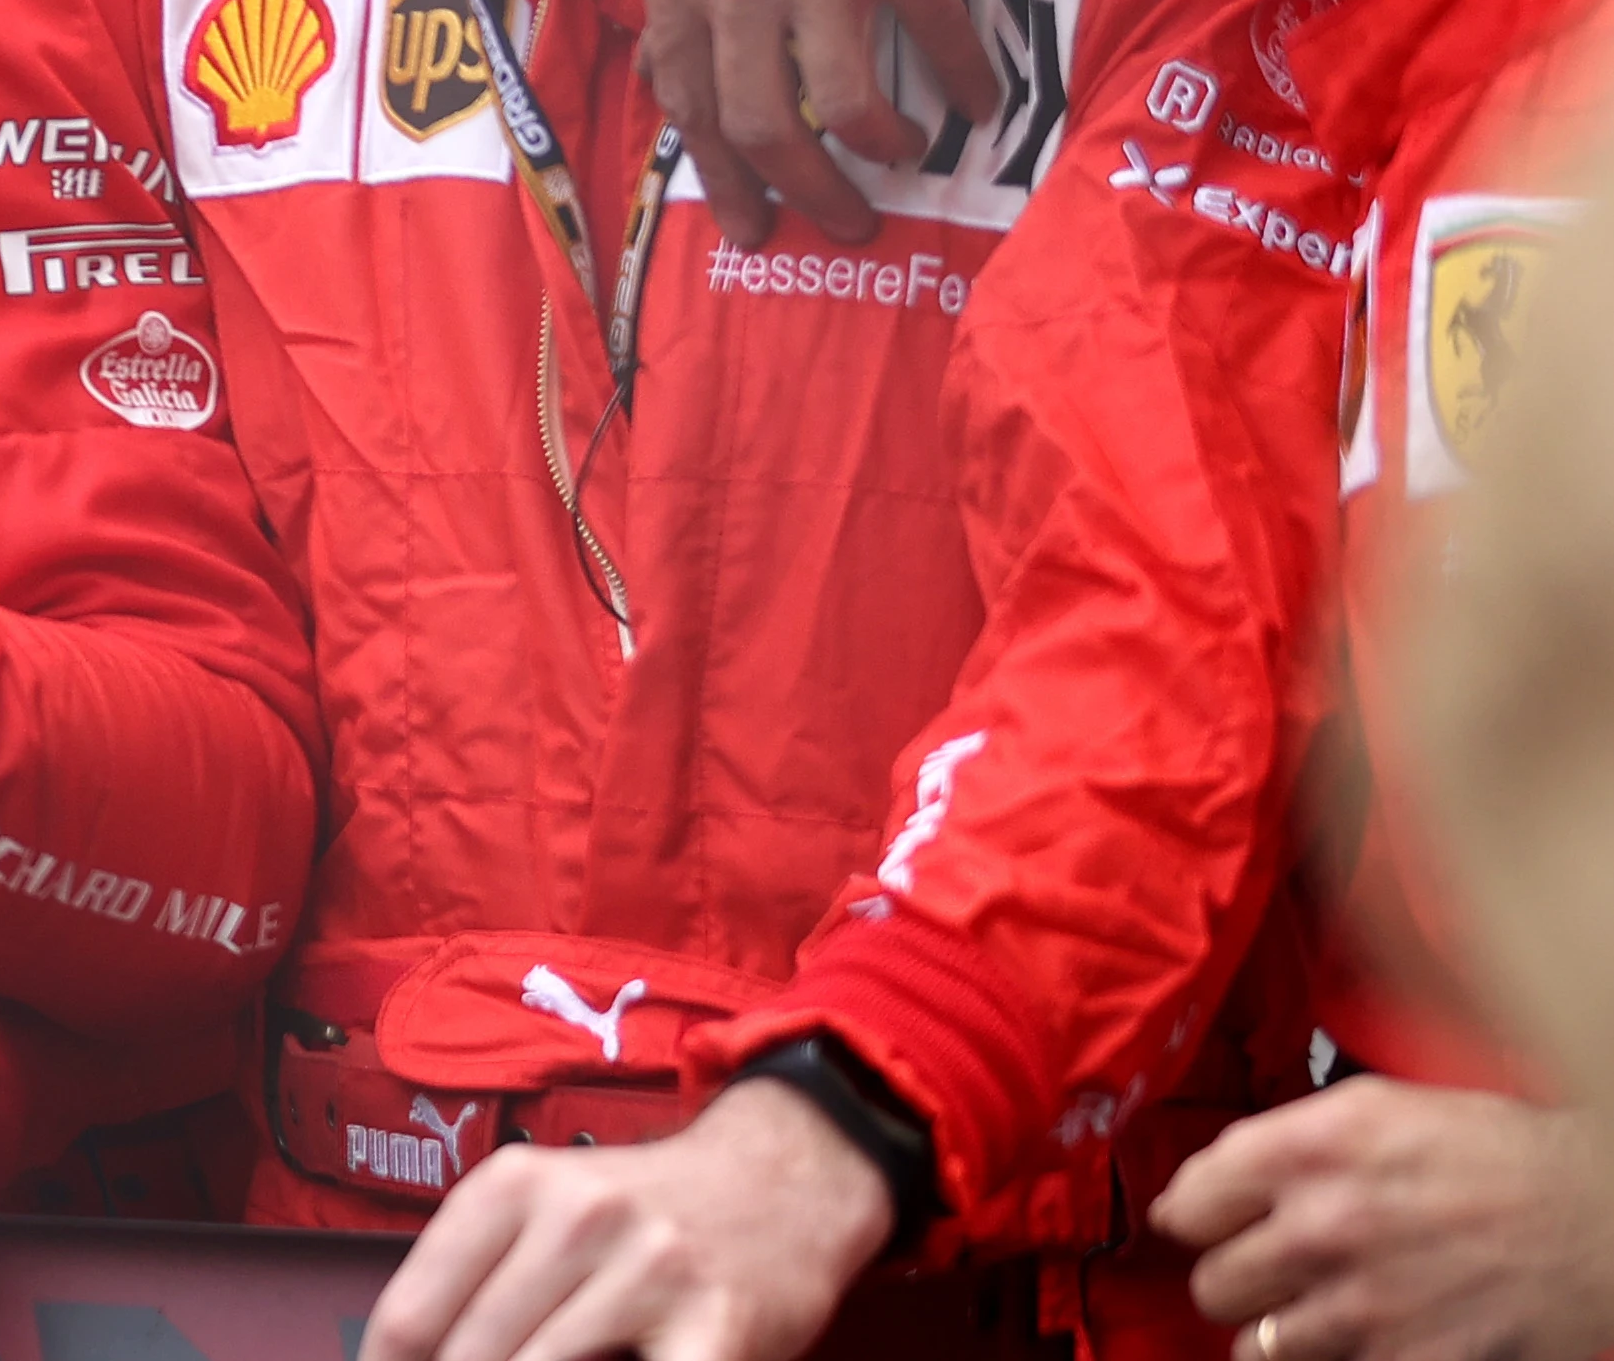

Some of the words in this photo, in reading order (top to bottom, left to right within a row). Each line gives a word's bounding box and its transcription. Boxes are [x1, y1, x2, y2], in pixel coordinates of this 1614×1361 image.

[99, 351, 203, 383] Estrella
[110, 379, 198, 411] Galicia
[345, 1124, 444, 1188] PUMA
